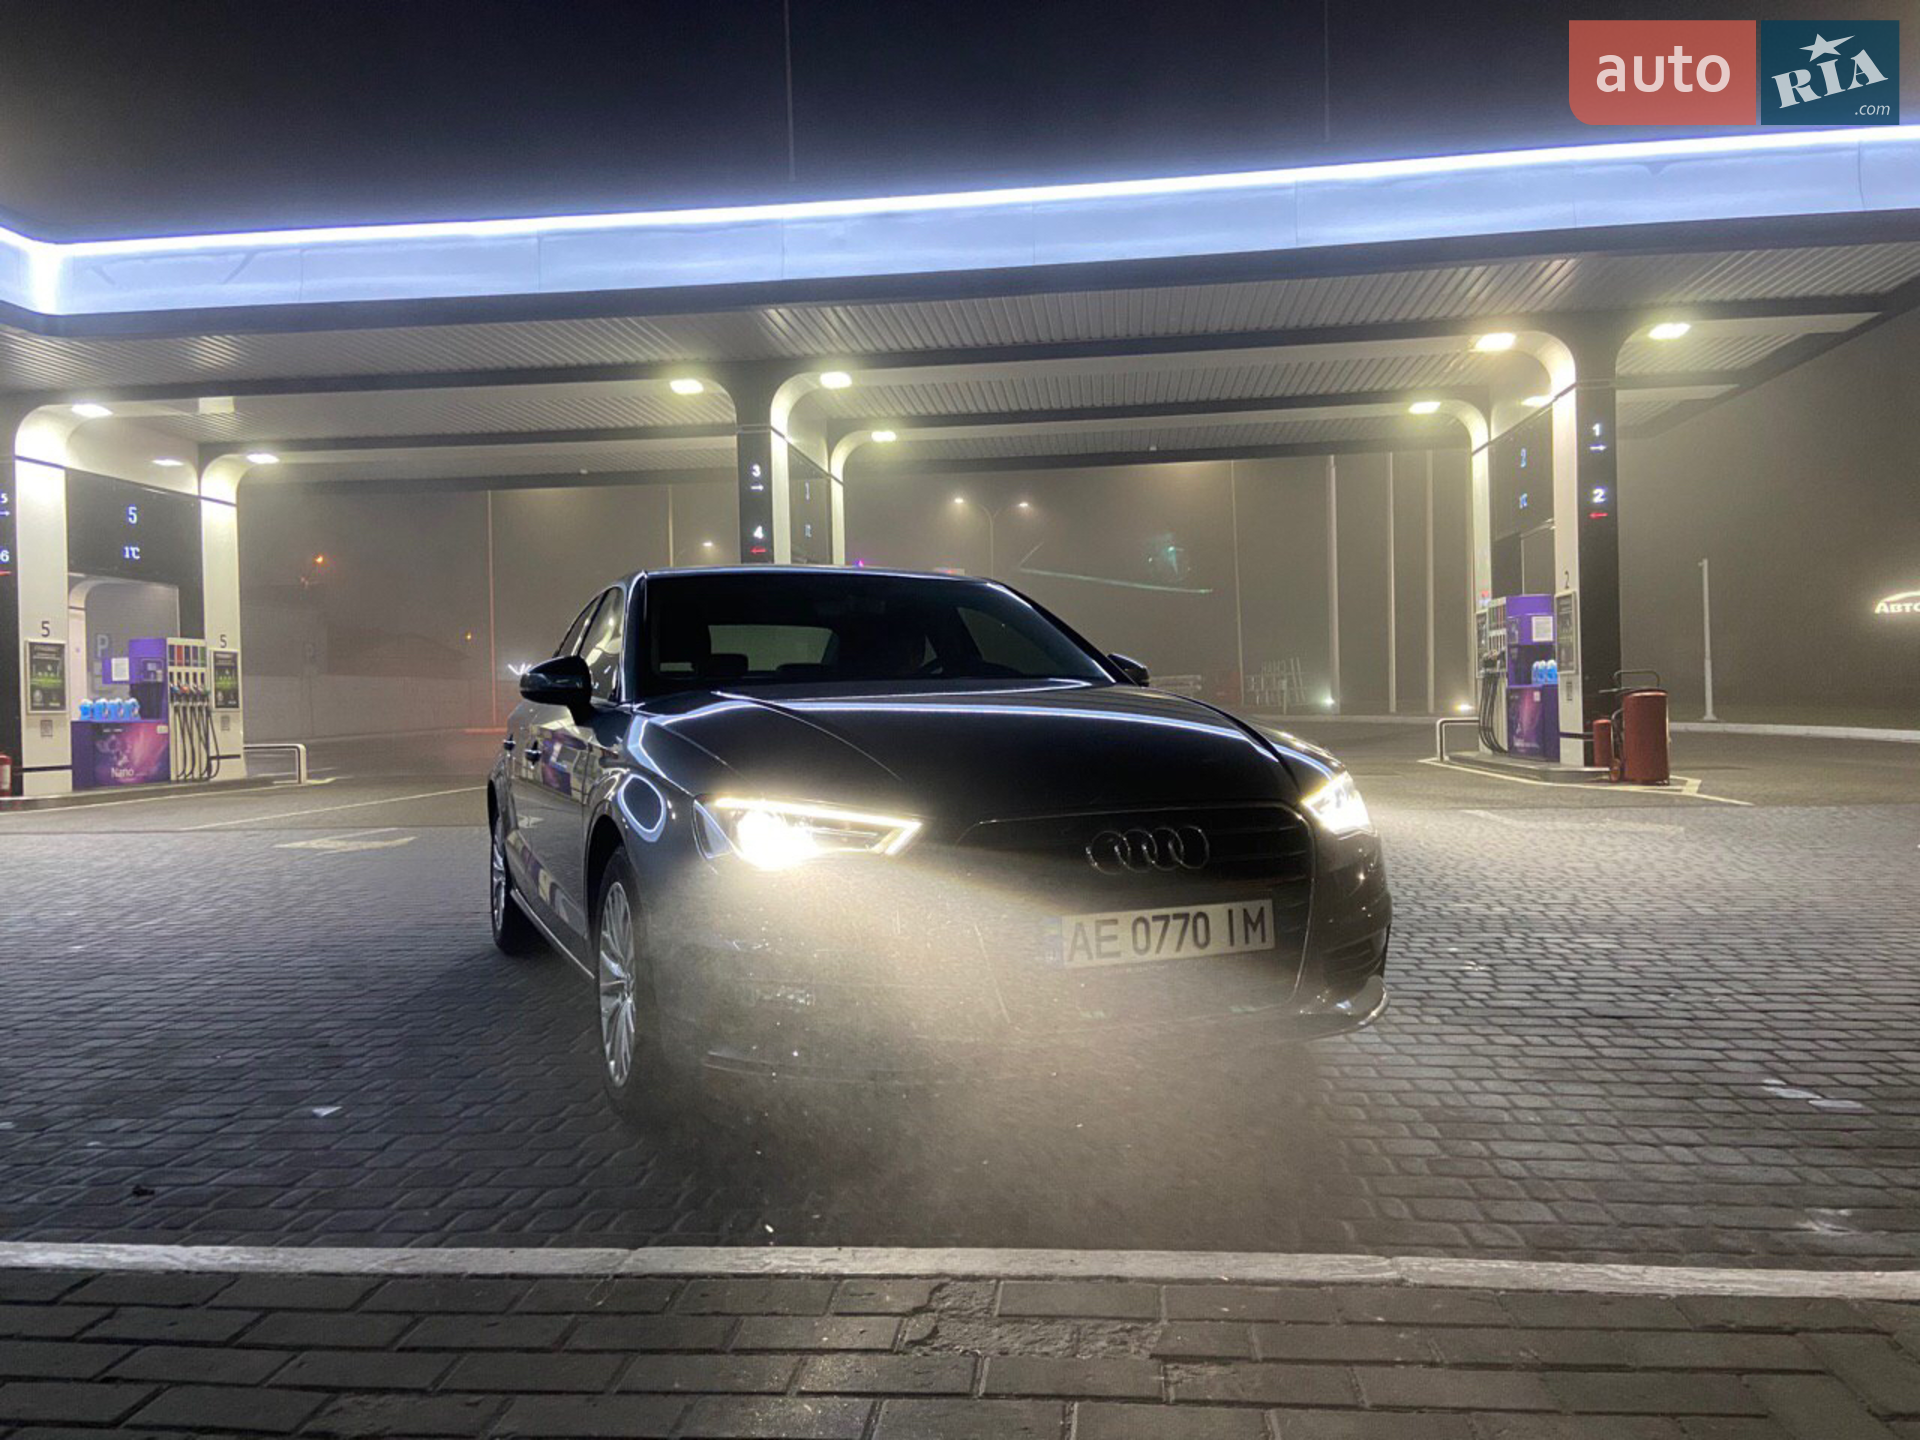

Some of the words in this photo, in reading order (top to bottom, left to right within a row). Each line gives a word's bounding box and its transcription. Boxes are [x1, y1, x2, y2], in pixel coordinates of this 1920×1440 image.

[1592, 423, 1601, 437] 1
[752, 464, 761, 477] 3
[1593, 488, 1606, 503] 2
[128, 506, 137, 525] 5
[753, 525, 764, 539] 4
[0, 549, 10, 562] 6
[41, 620, 51, 637] 5
[219, 634, 227, 648] 5
[1067, 918, 1121, 962] AE
[1131, 911, 1211, 956] 0770
[1228, 906, 1267, 947] IM
